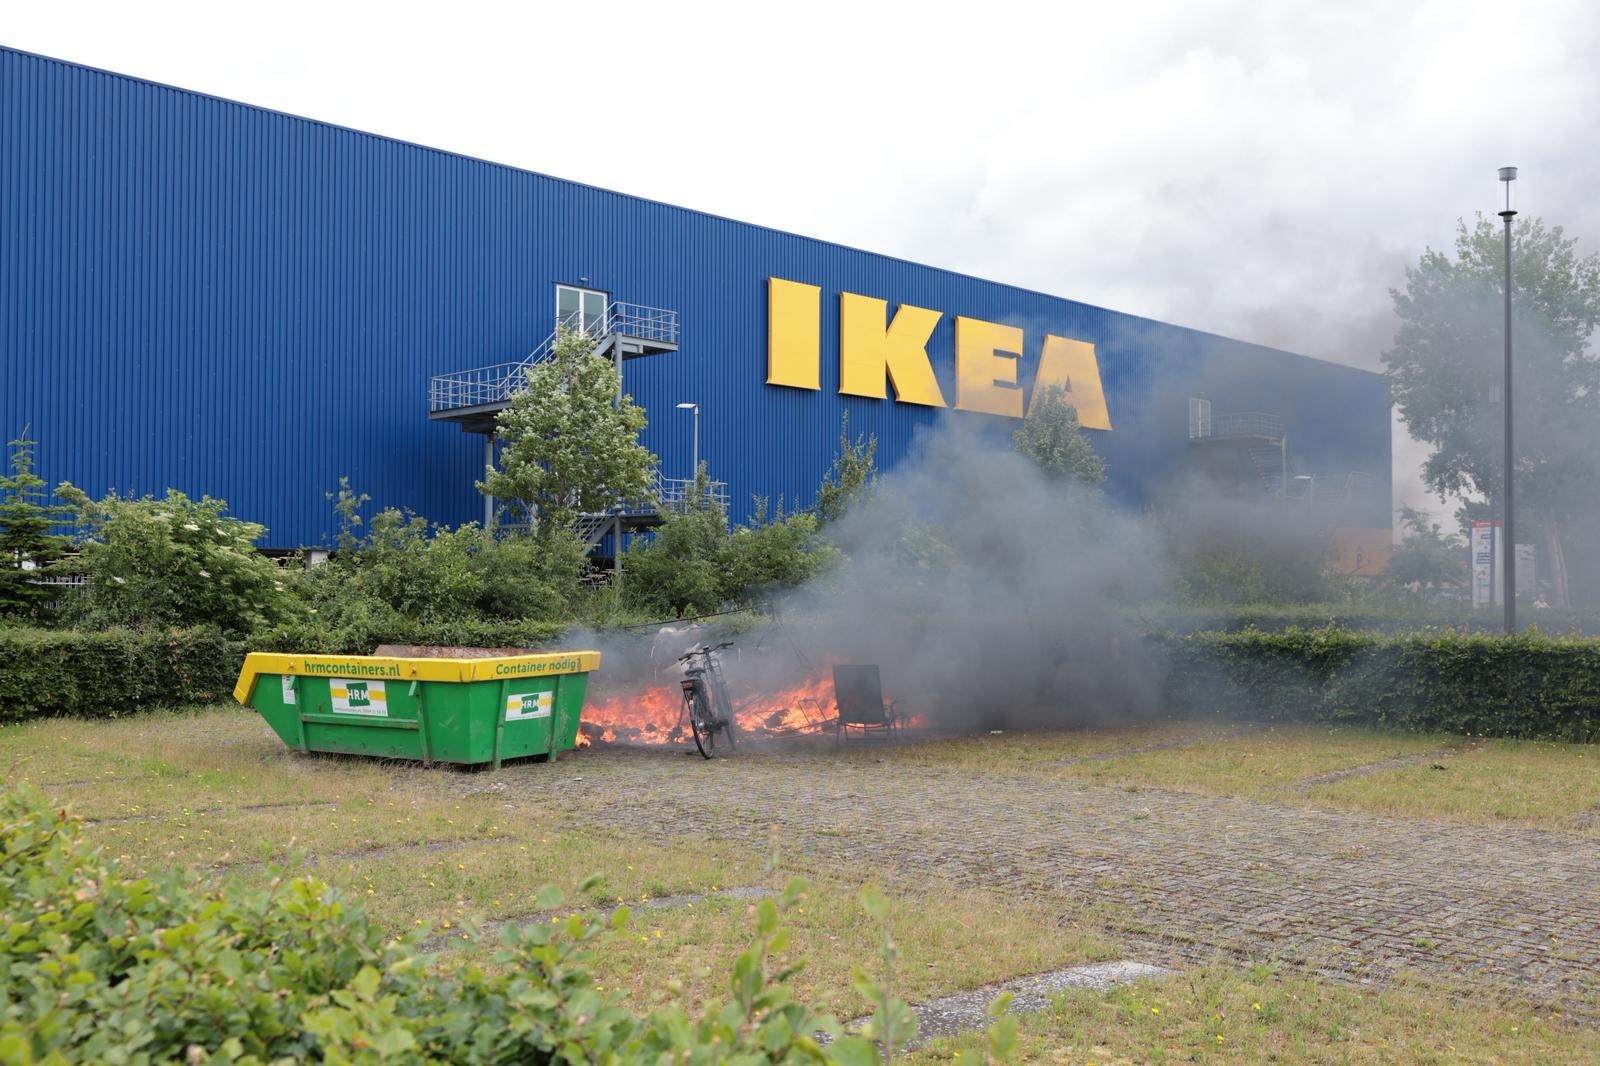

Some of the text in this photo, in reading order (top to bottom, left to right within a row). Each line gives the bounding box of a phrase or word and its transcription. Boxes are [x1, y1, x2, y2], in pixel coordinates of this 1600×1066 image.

[765, 277, 1112, 431] IKEA
[304, 660, 400, 676] hrmcontainers.nl
[495, 662, 547, 675] Container
[347, 688, 370, 701] HRM
[521, 698, 540, 709] HRM
